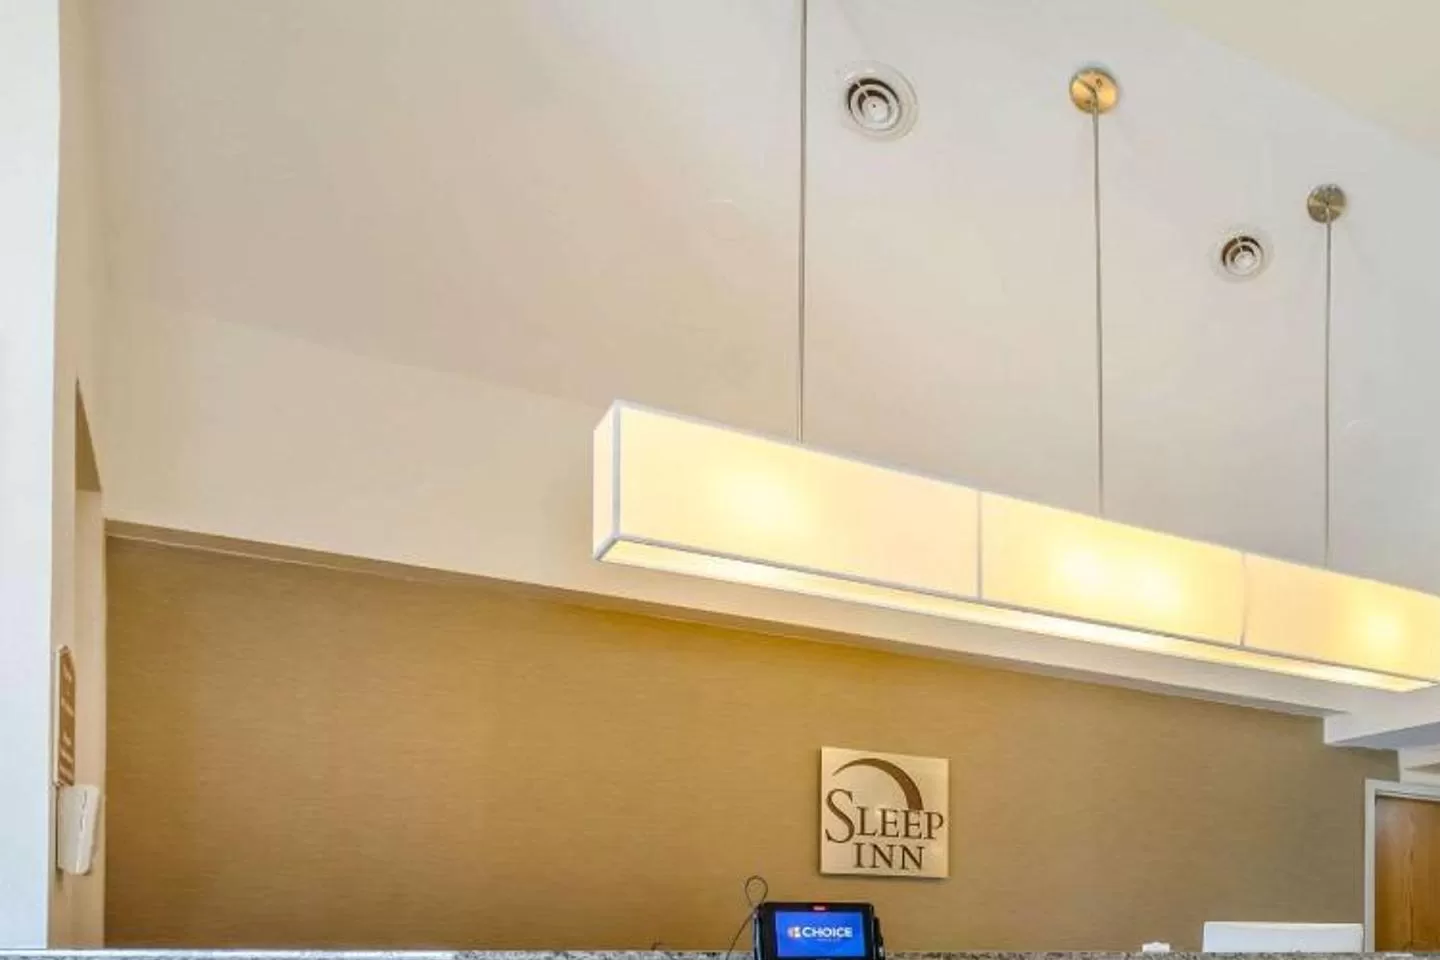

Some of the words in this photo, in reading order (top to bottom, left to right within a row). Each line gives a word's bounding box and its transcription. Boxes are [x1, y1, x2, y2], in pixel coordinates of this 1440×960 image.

[825, 788, 944, 844] SLEEP
[853, 842, 925, 870] INN
[802, 926, 853, 938] CHOICE
